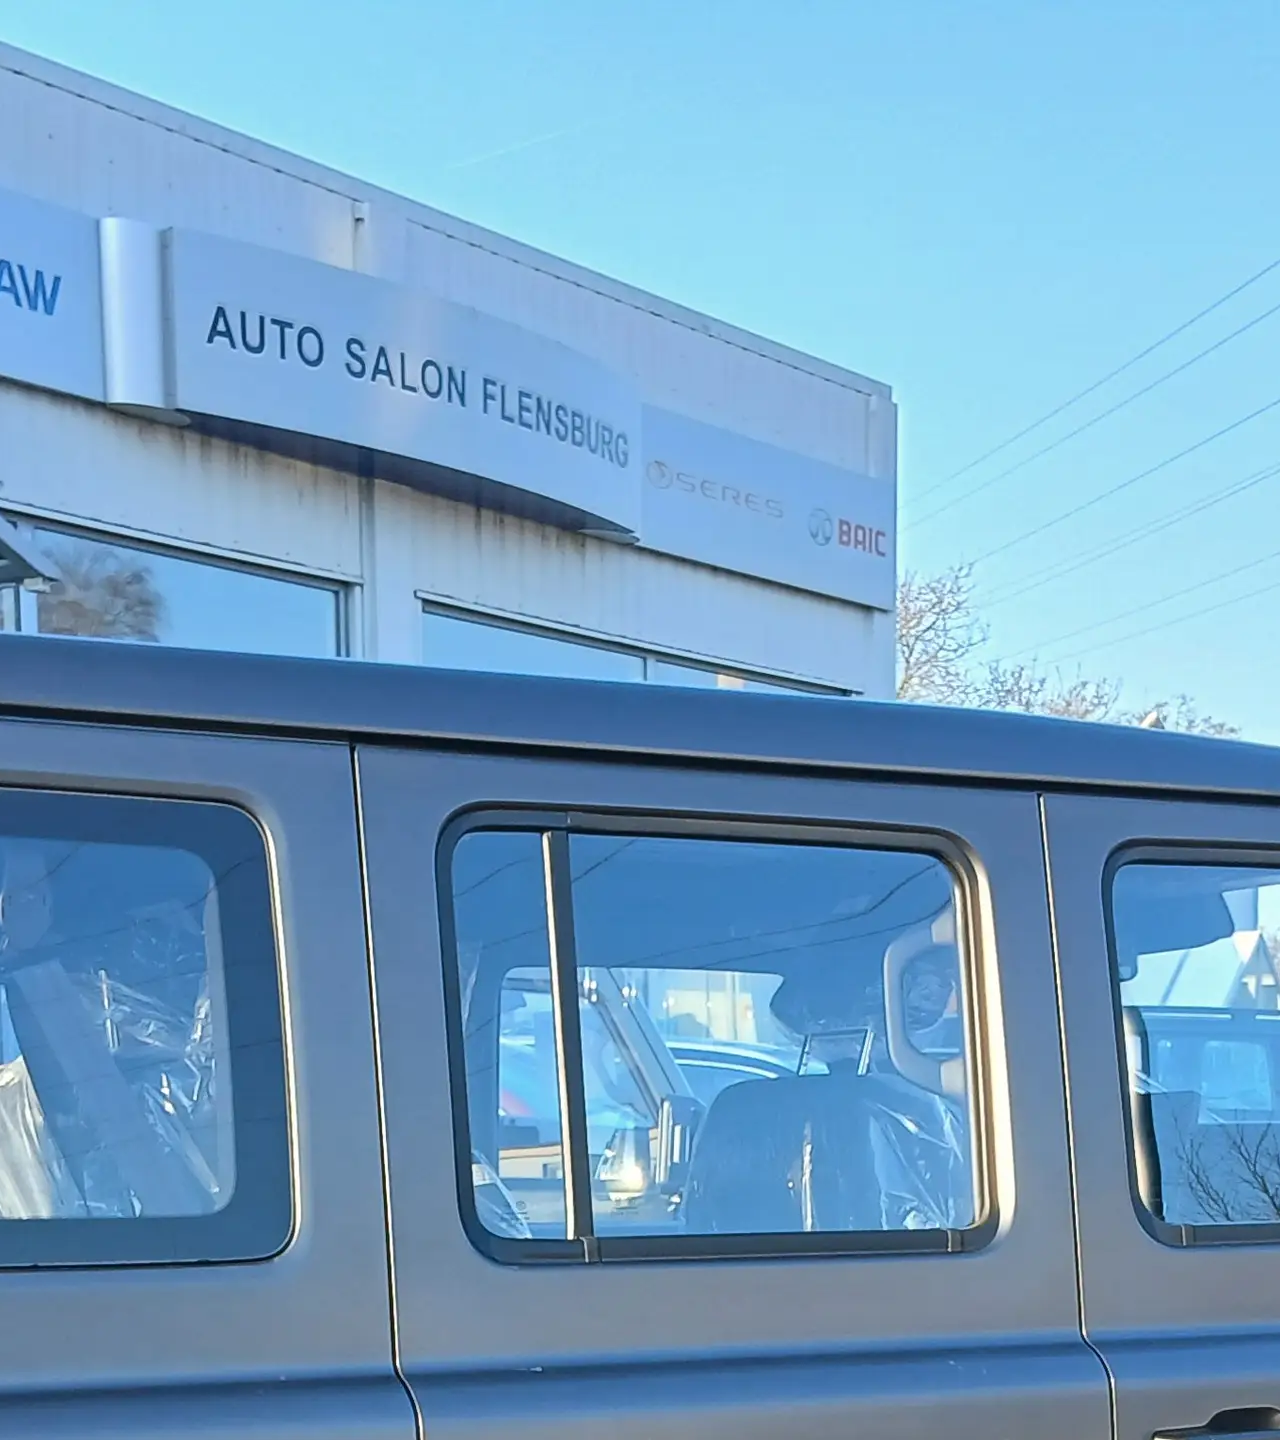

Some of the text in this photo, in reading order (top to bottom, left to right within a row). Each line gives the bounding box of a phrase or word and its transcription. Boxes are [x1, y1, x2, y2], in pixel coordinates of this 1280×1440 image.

[206, 305, 630, 469] AUTO SALON FLENSBURG
[676, 471, 784, 519] SERES
[837, 517, 887, 558] BAIC
